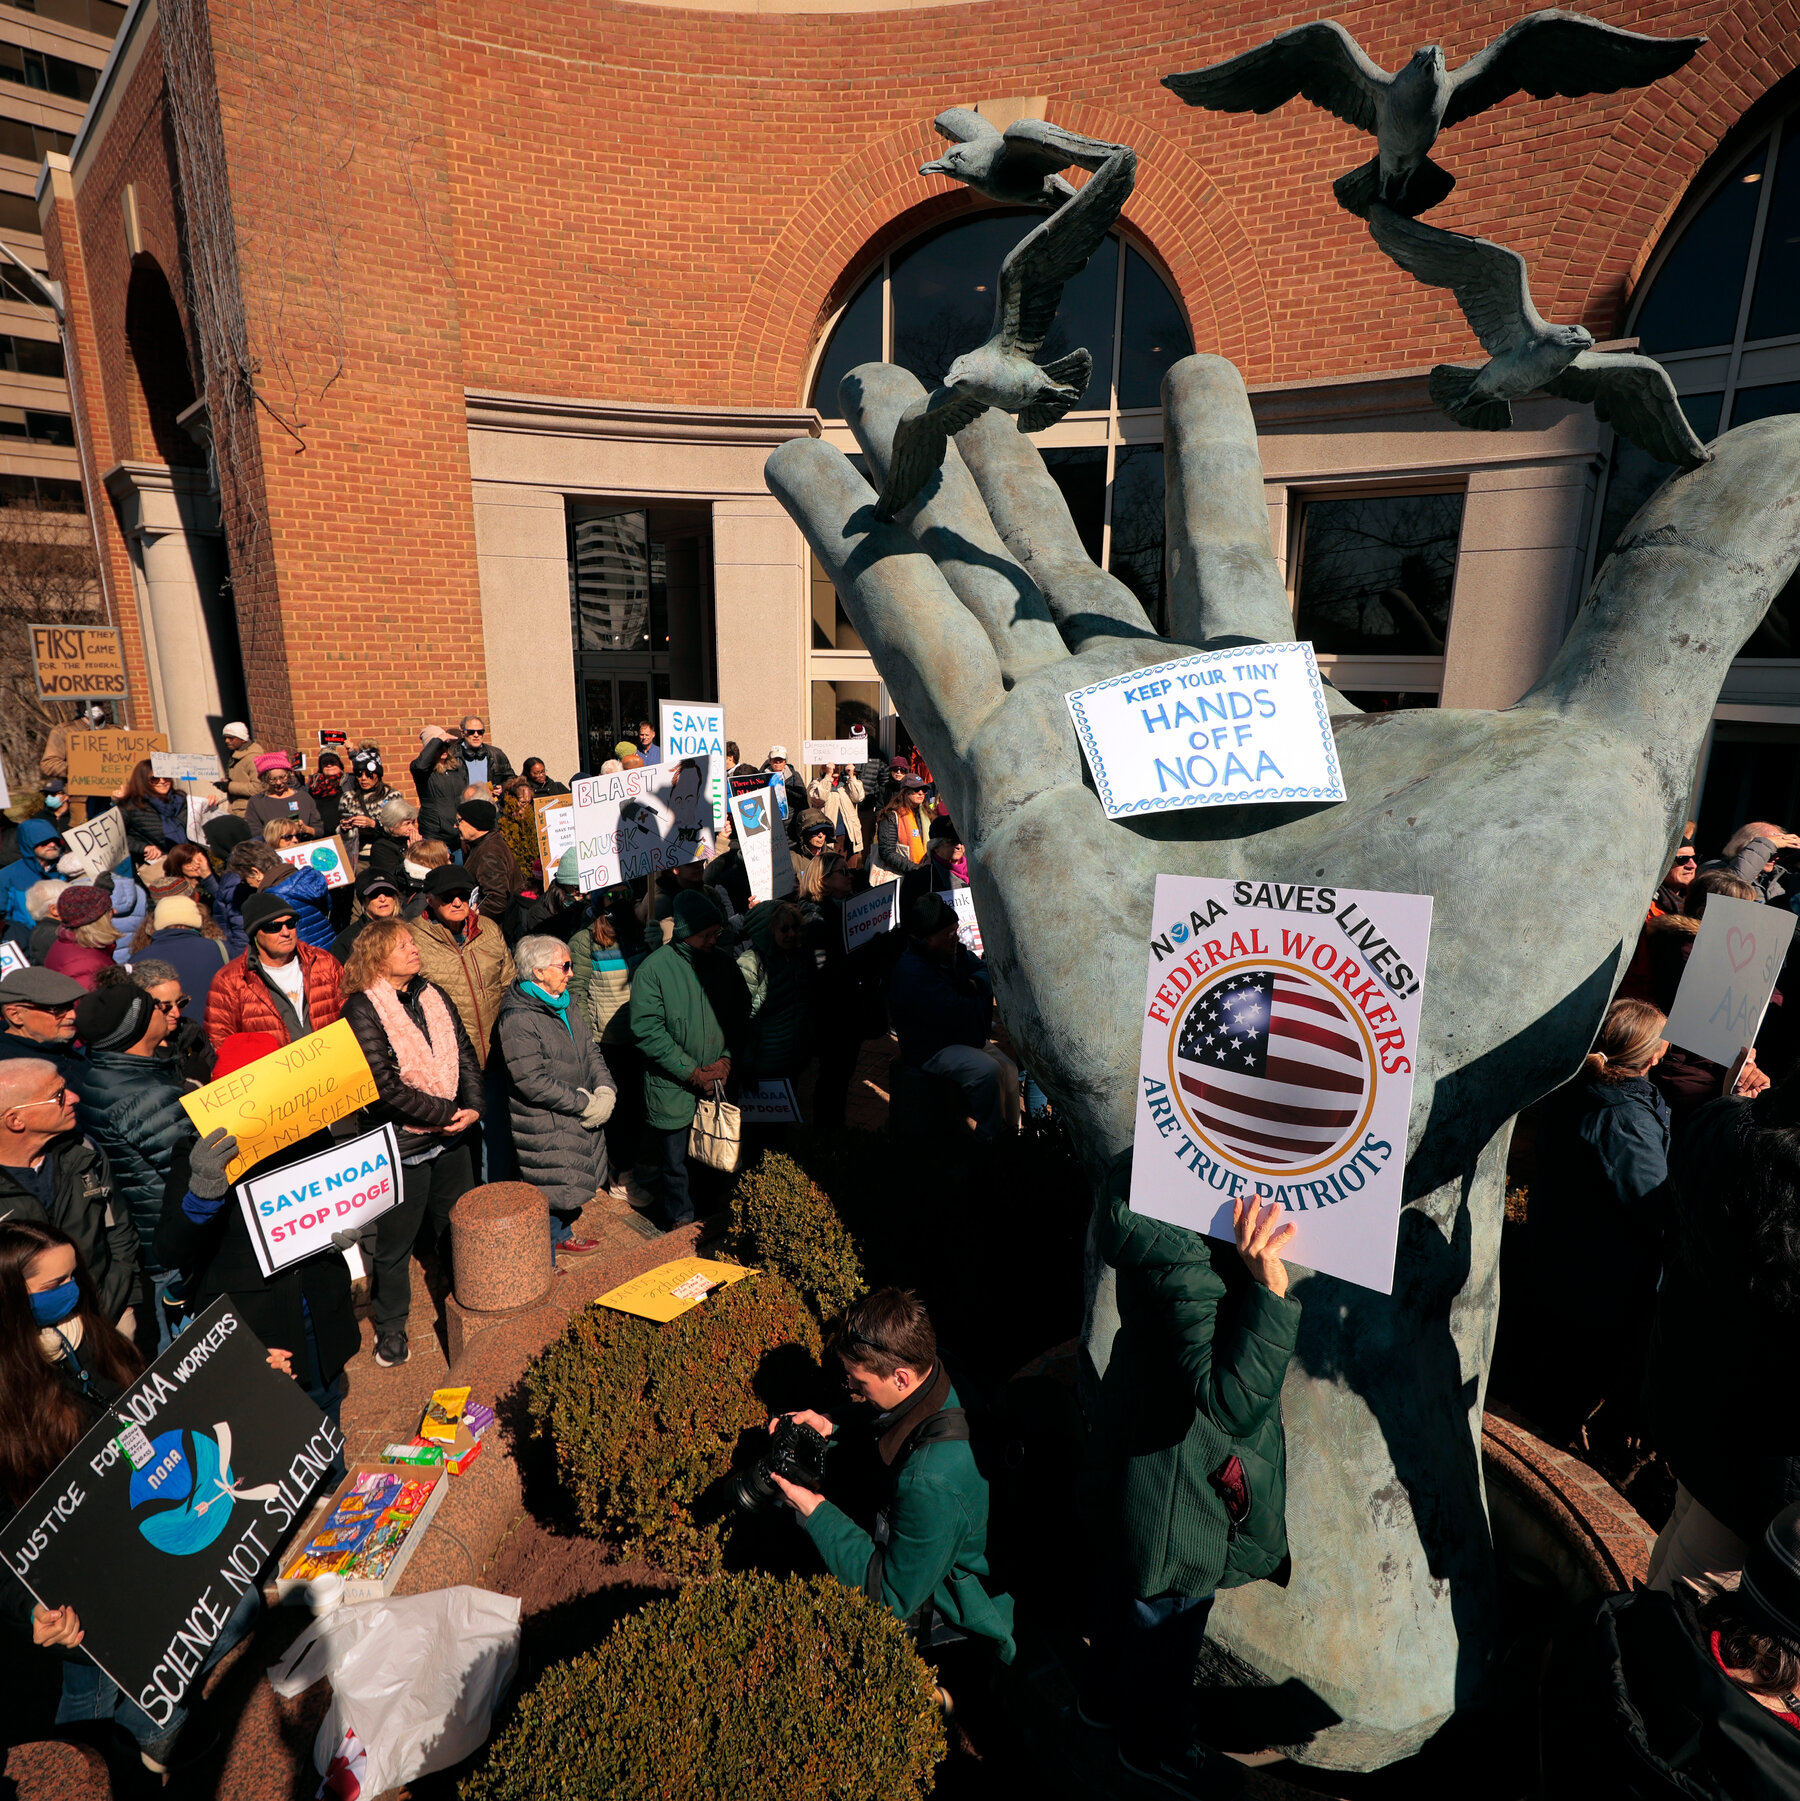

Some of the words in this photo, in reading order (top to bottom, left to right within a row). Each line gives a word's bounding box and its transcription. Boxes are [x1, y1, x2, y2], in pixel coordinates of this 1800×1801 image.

[32, 628, 85, 660] FIRST
[88, 631, 115, 639] THEY
[87, 645, 116, 654] CAME
[39, 662, 56, 670] FOR
[39, 674, 125, 693] WORKERS
[1123, 679, 1172, 705] KEEP
[1176, 669, 1226, 690] YOUR
[1233, 663, 1279, 681] TINY
[672, 711, 719, 732] SAVE
[1141, 688, 1276, 733] HANDS
[70, 735, 109, 752] FIRE
[116, 736, 160, 752] MUSK
[102, 752, 137, 763] NOW!
[670, 736, 723, 756] NOAA
[1188, 724, 1253, 750] OFF
[577, 768, 657, 808] BLAST
[1153, 750, 1284, 793] NOAA
[74, 810, 121, 856] DEFY
[579, 826, 639, 860] MUSK
[580, 865, 609, 891] TO
[621, 843, 680, 881] MARS
[847, 904, 869, 921] SAVE
[869, 894, 893, 912] NOAA
[848, 922, 872, 937] STOP
[872, 909, 893, 926] DOGE
[1234, 880, 1337, 914] SAVES
[1335, 902, 1420, 1000] LIVES!
[1147, 928, 1269, 1027] FEDERAL
[1281, 928, 1411, 1075] WORKERS
[200, 1073, 255, 1112] KEEP
[275, 1037, 332, 1073] YOUR
[226, 1142, 265, 1177] OFF
[273, 1124, 301, 1149] MY
[309, 1079, 378, 1130] SCIENCE
[235, 1076, 339, 1140] Sharpie
[757, 1105, 791, 1113] DOGE
[1143, 1075, 1181, 1138] ARE
[1174, 1135, 1247, 1201] TRUE
[1254, 1133, 1393, 1212] PATRIOTS
[259, 1181, 322, 1217] SAVE
[324, 1153, 389, 1191] NOAA
[270, 1208, 330, 1243] STOP
[335, 1178, 390, 1217] DOGE
[16, 1480, 86, 1575] JUSTICE
[90, 1437, 122, 1477] FOR
[118, 1372, 177, 1428] NOAA
[173, 1313, 238, 1384] WORKERS
[147, 1448, 182, 1490] NOAA
[140, 1586, 230, 1726] SCIENCE
[220, 1519, 270, 1597] NOT
[264, 1416, 345, 1533] SILENCE
